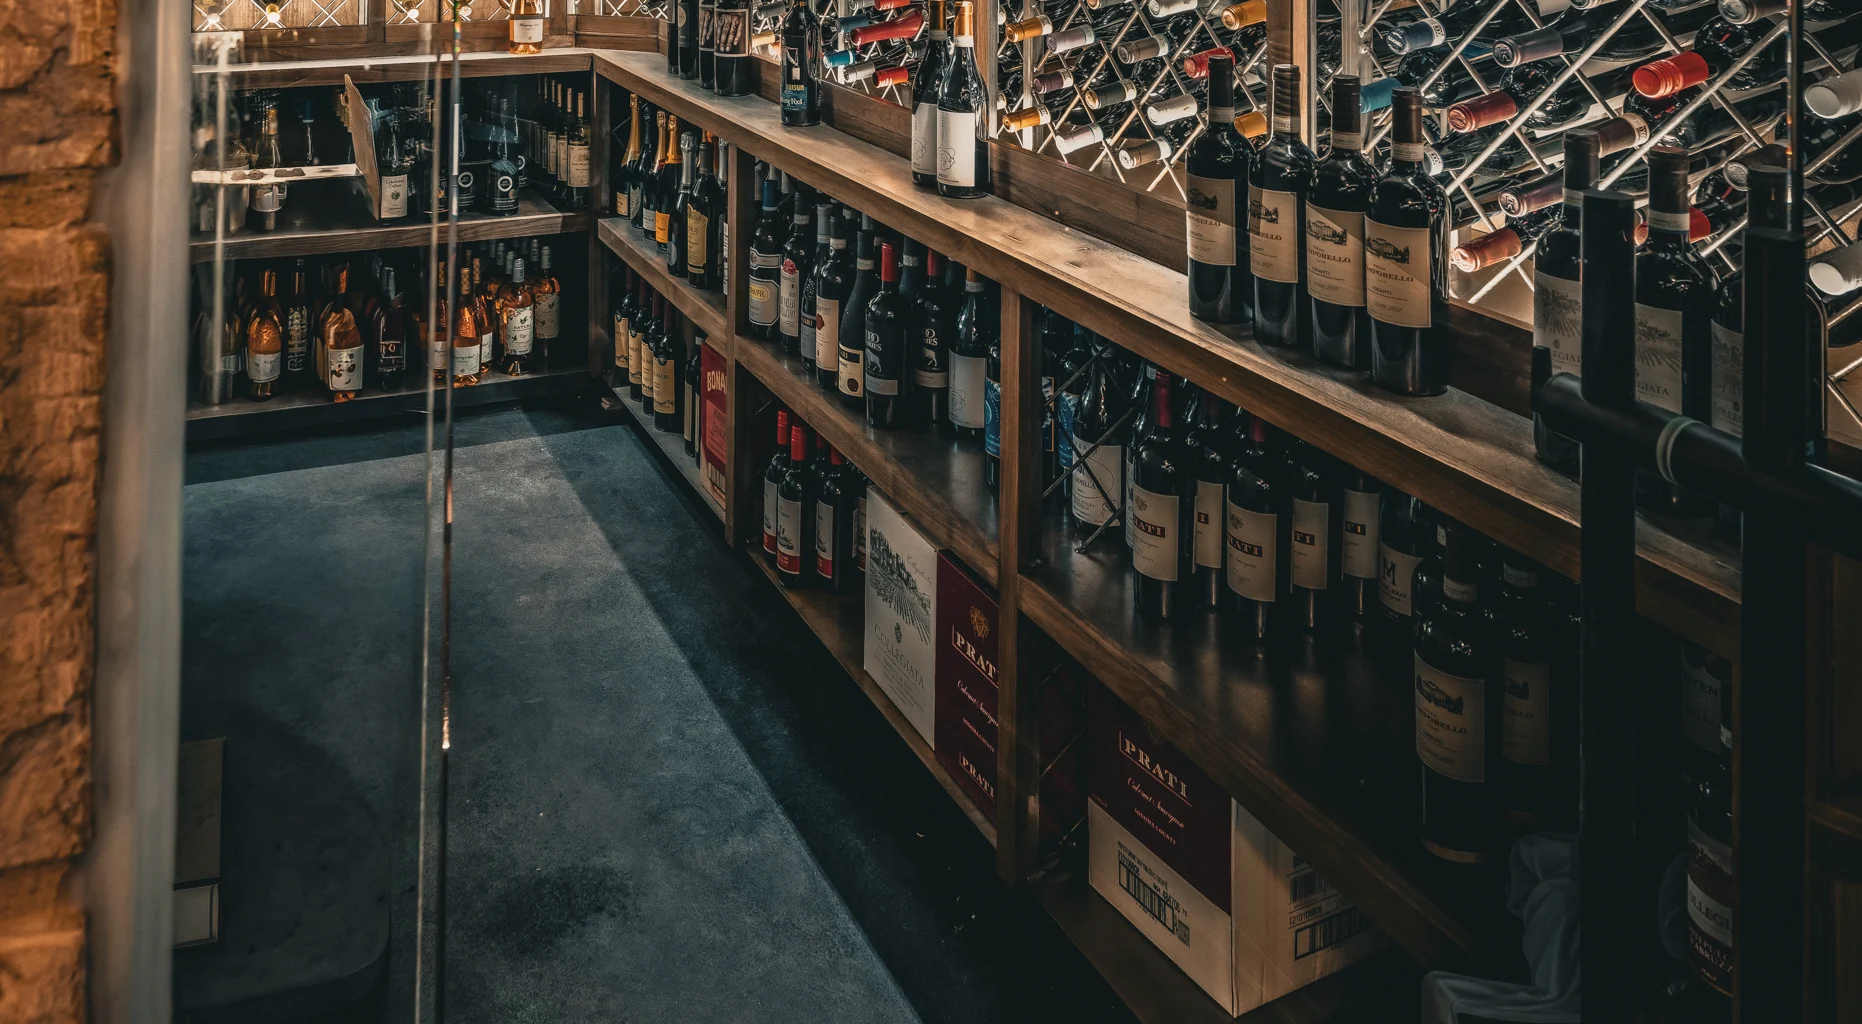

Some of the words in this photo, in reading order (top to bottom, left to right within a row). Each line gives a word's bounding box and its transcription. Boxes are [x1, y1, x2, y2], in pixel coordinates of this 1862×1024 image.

[706, 370, 728, 394] BONA
[874, 624, 925, 691] COLLEGIATA
[962, 755, 995, 798] PRATI
[1124, 738, 1188, 798] PRATI
[1127, 777, 1152, 802] Cabernet
[1134, 807, 1155, 829] SONOMA
[1152, 799, 1185, 829] Sauvignon
[1155, 825, 1177, 846] COUNTY
